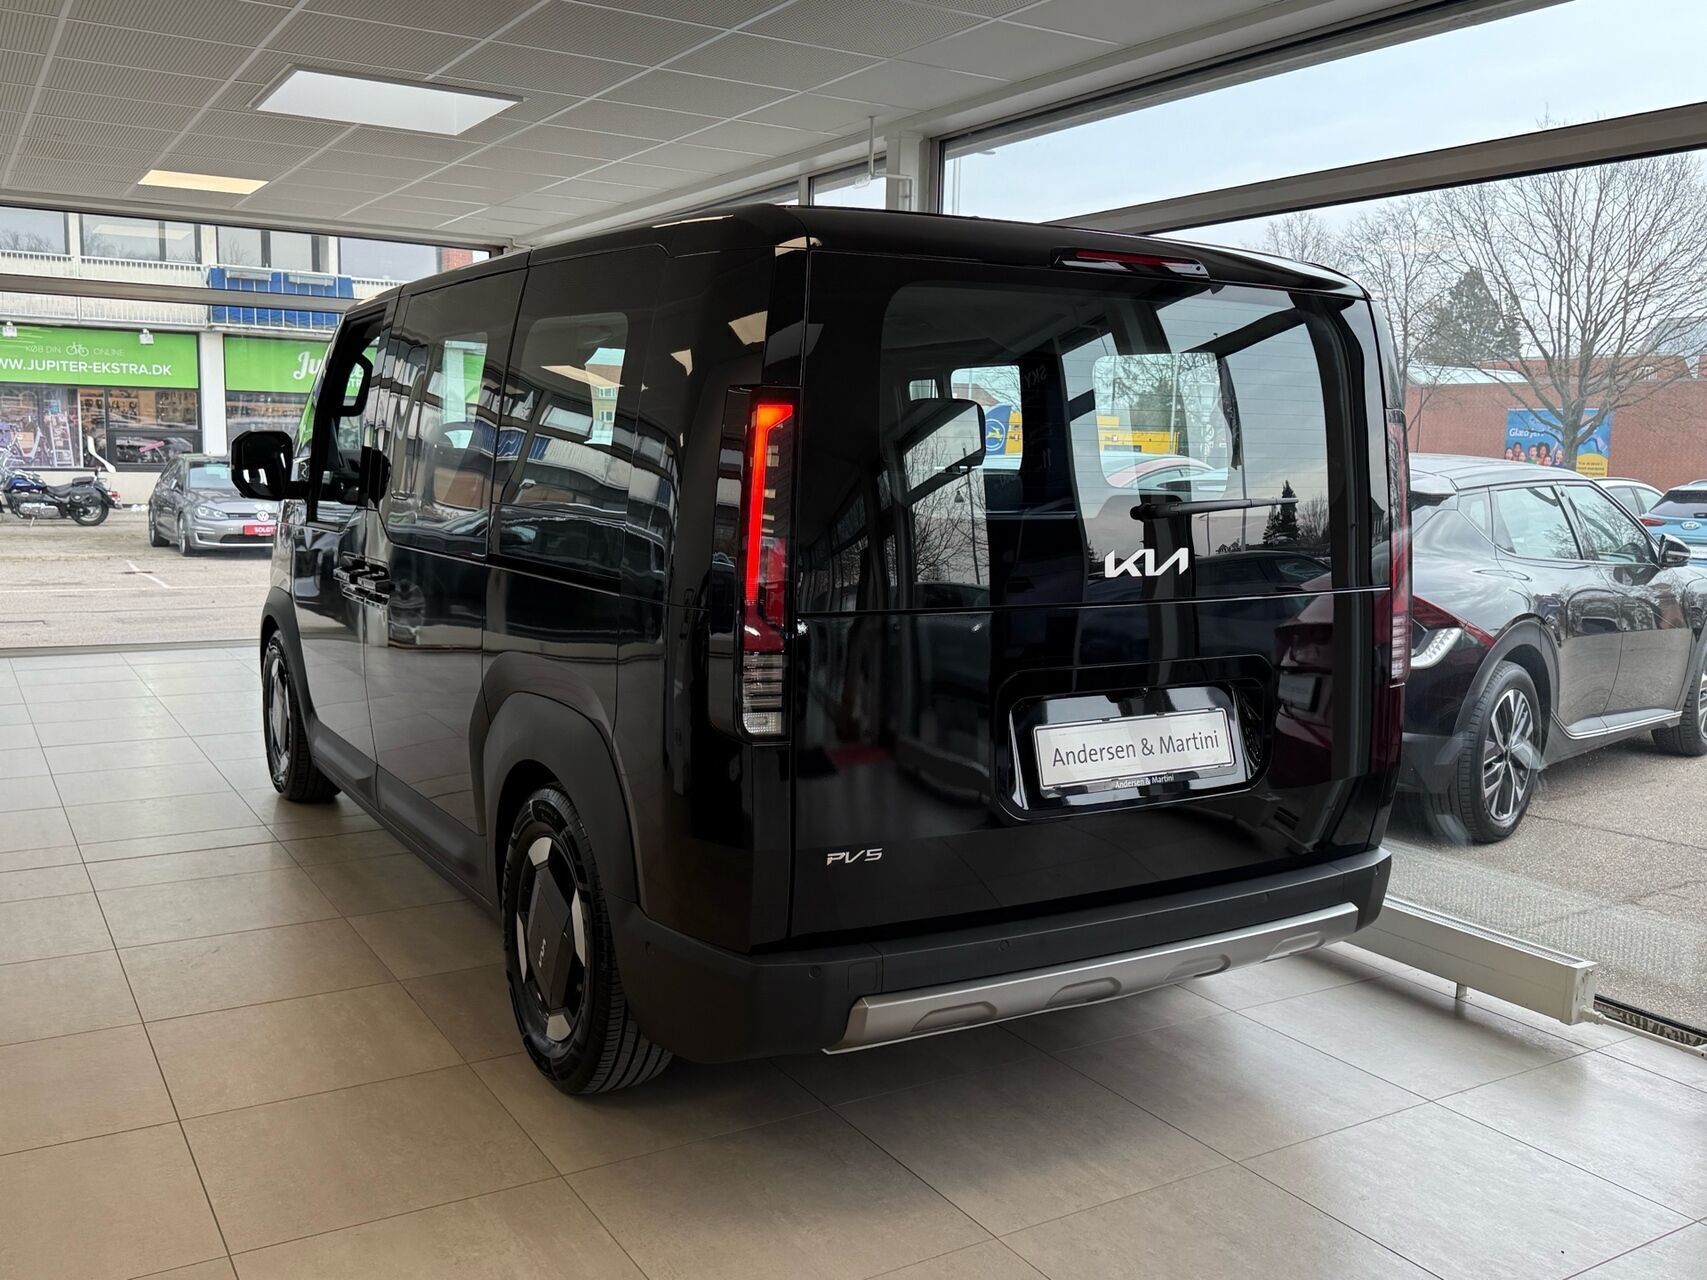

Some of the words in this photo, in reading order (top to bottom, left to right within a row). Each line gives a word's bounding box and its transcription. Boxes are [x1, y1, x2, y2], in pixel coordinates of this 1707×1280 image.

[46, 346, 61, 354] DIN
[93, 348, 125, 356] ONLINE
[1105, 547, 1189, 578] KIA
[1052, 743, 1136, 767] Andersen
[1141, 738, 1154, 756] &
[1159, 730, 1219, 754] Martini
[1115, 779, 1145, 788] Andersen
[1145, 777, 1152, 785] &
[1152, 775, 1174, 784] Martini
[827, 848, 883, 866] PV5
